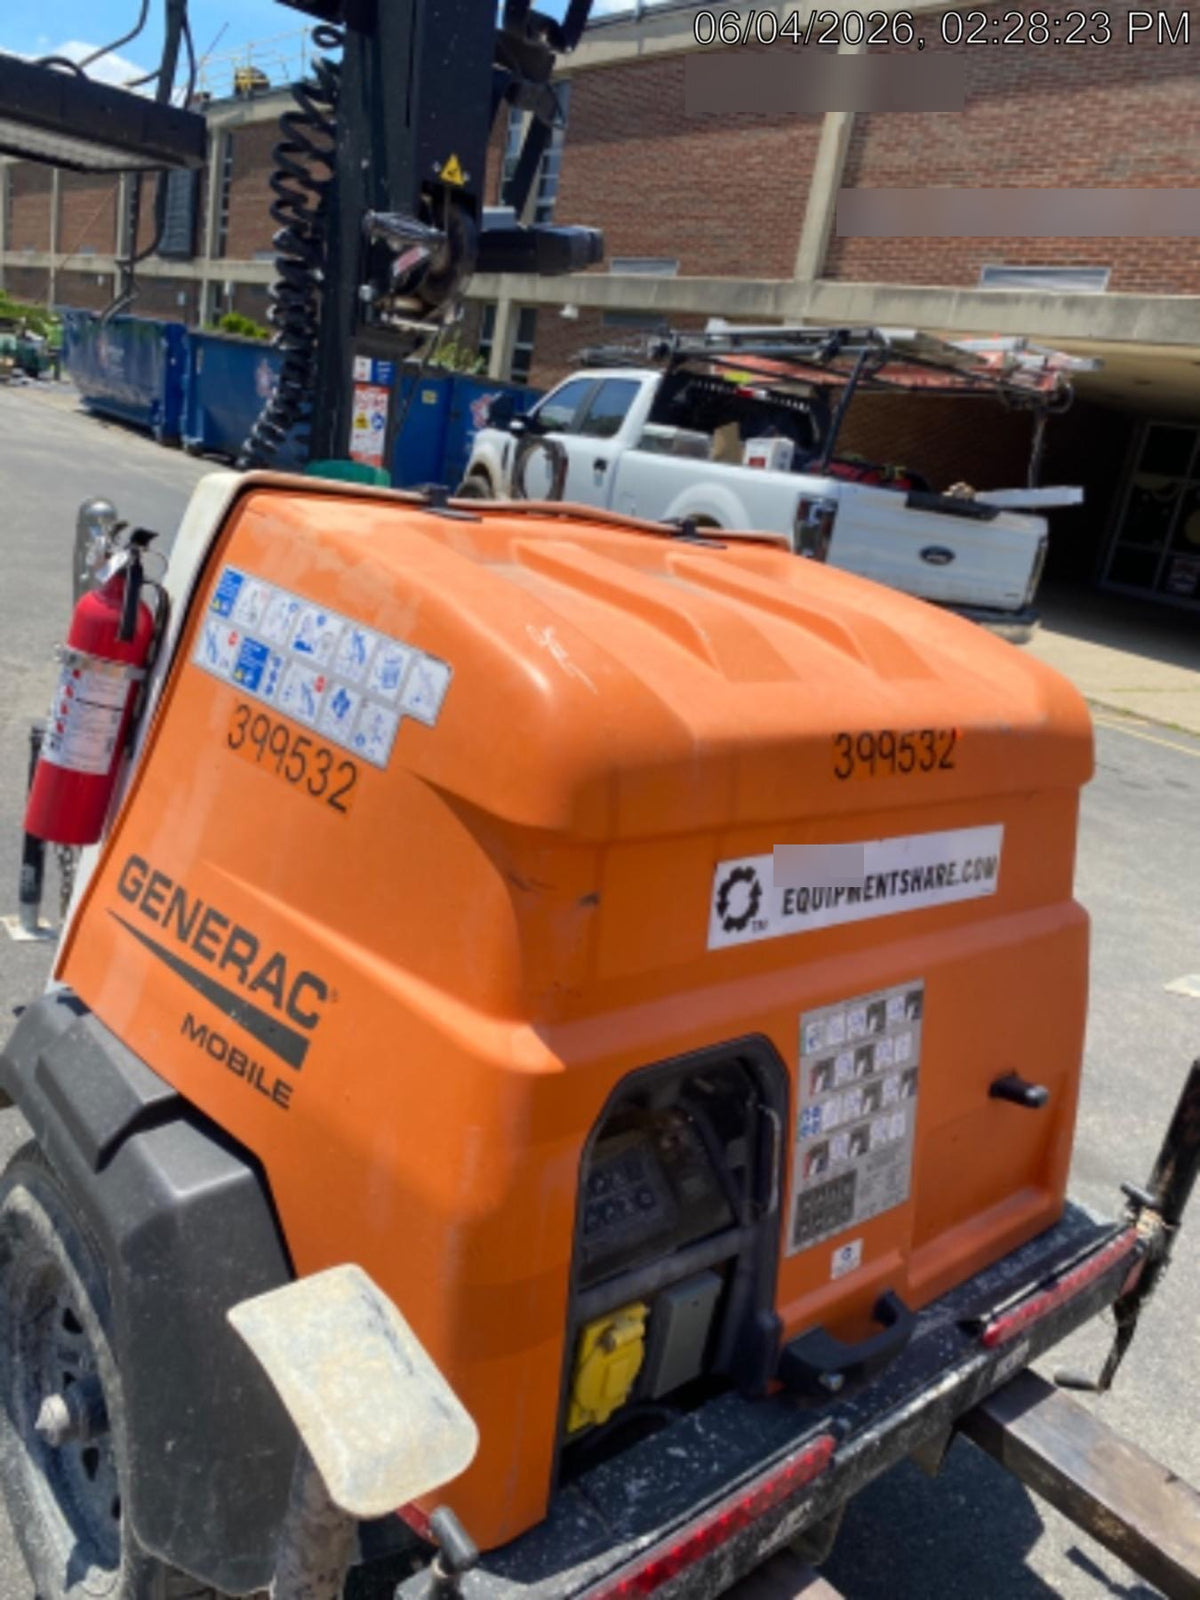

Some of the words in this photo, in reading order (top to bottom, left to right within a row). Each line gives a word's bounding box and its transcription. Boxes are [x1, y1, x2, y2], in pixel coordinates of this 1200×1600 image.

[227, 705, 358, 813] 399532
[834, 728, 958, 780] 399532
[116, 854, 329, 1030] GENERAC
[180, 1012, 294, 1110] MOBILE
